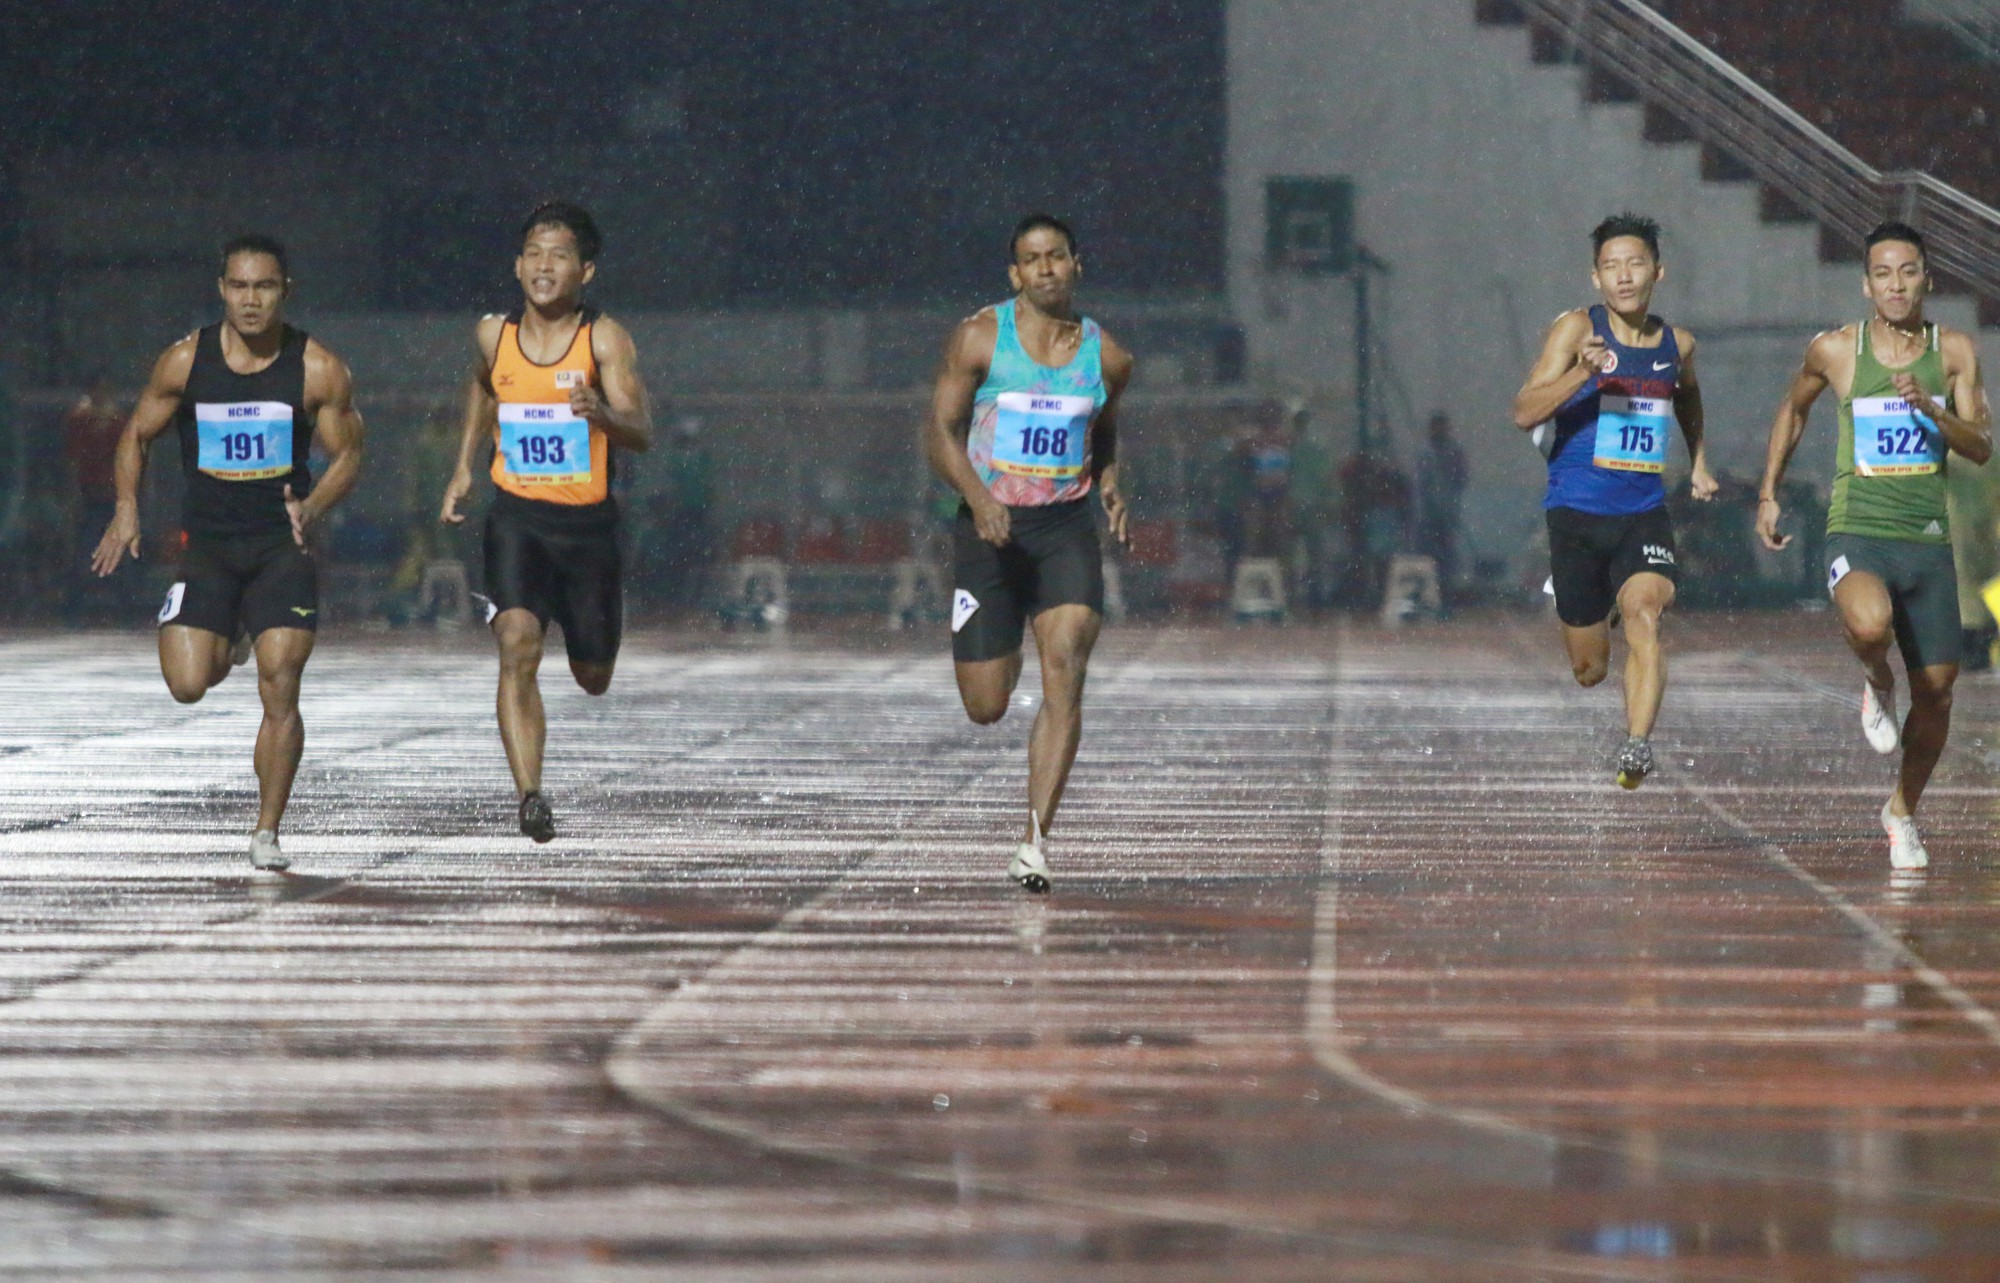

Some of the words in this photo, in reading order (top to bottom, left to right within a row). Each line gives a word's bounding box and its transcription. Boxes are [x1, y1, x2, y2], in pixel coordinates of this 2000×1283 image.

[228, 407, 261, 418] HCMC
[523, 408, 555, 419] HCMC
[1031, 399, 1062, 411] HCMC
[1627, 401, 1654, 412] HCMC
[221, 432, 265, 461] 191
[517, 435, 566, 465] 193
[1019, 426, 1069, 457] 168
[1618, 425, 1654, 454] 175
[1877, 427, 1928, 456] 522
